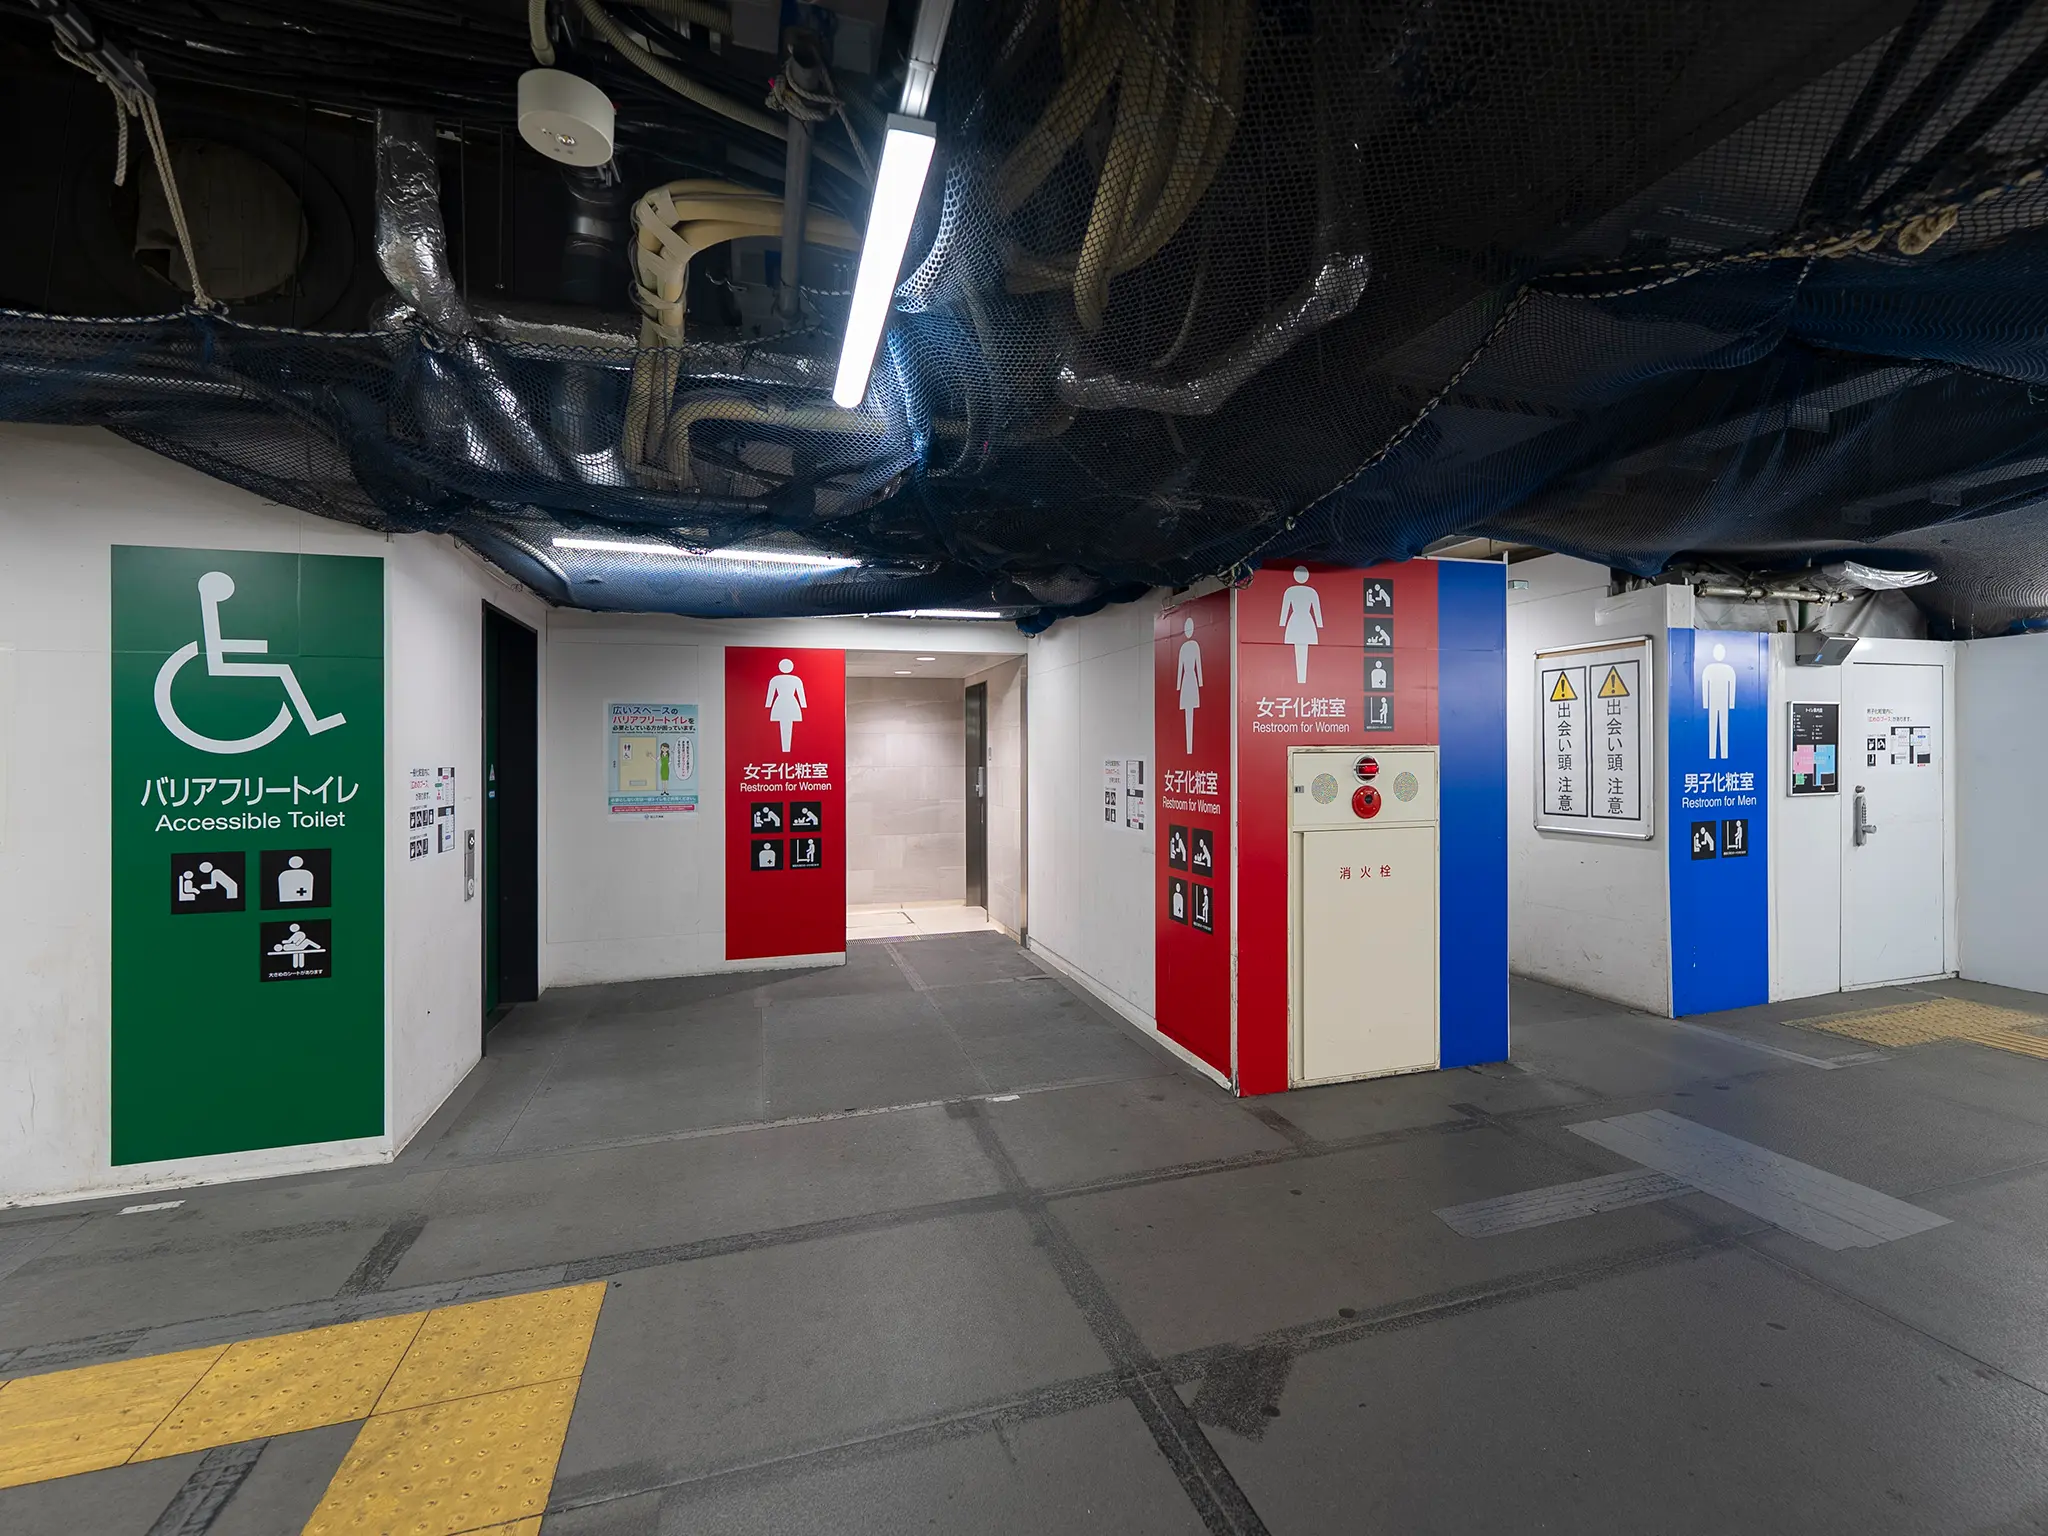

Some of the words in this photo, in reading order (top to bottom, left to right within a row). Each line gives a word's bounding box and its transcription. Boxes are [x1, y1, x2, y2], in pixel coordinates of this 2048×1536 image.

[612, 706, 679, 715] 広いスペースの
[1256, 696, 1346, 718] 女子化粧室
[612, 715, 695, 725] バリアフリートイレを
[1252, 722, 1298, 733] Restroom
[1300, 721, 1313, 733] for
[1315, 721, 1350, 733] Women
[743, 762, 829, 780] 女子化粧室
[740, 783, 783, 792] Restroom
[785, 782, 797, 791] for
[799, 781, 832, 791] Women
[1164, 769, 1218, 796] 女子化粧室
[1684, 772, 1755, 794] 男子化粧室
[140, 775, 359, 808] バリアフリートイレ
[1162, 796, 1188, 812] Restroom
[1188, 798, 1197, 811] for
[1197, 799, 1221, 815] Women
[1682, 797, 1722, 809] Restroom
[1724, 796, 1735, 807] for
[1737, 795, 1757, 806] Men
[155, 812, 281, 832] Accessible
[287, 811, 346, 828] Toilet
[1339, 864, 1392, 880] 消火栓
[268, 969, 323, 978] 大きめのシートがあります
